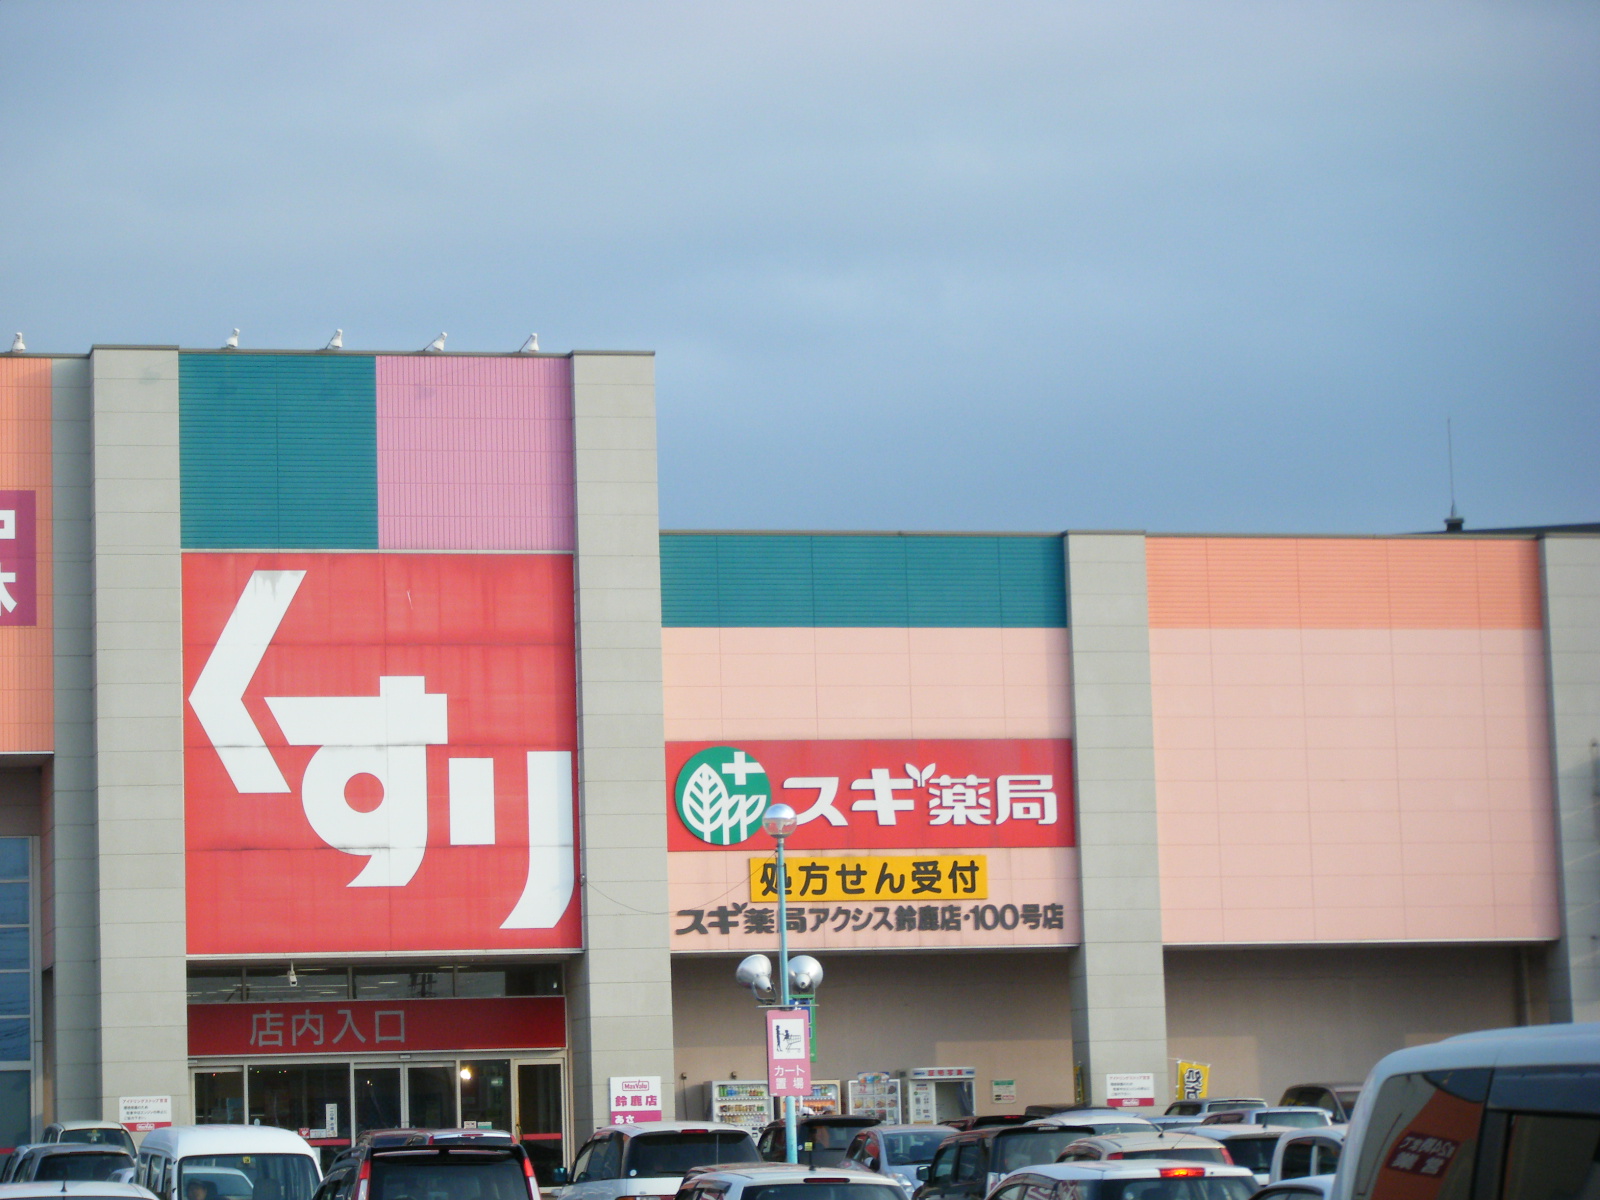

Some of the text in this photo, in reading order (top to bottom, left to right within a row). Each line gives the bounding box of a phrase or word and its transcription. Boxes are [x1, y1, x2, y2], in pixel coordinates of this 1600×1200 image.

[188, 570, 575, 929] くすり
[783, 763, 1057, 826] スギ薬局
[760, 860, 980, 896] 処方せん受付
[250, 1009, 405, 1046] 店内入口
[774, 1065, 806, 1076] カート
[775, 1077, 804, 1090] 置場
[615, 1095, 657, 1107] 鈴鹿店
